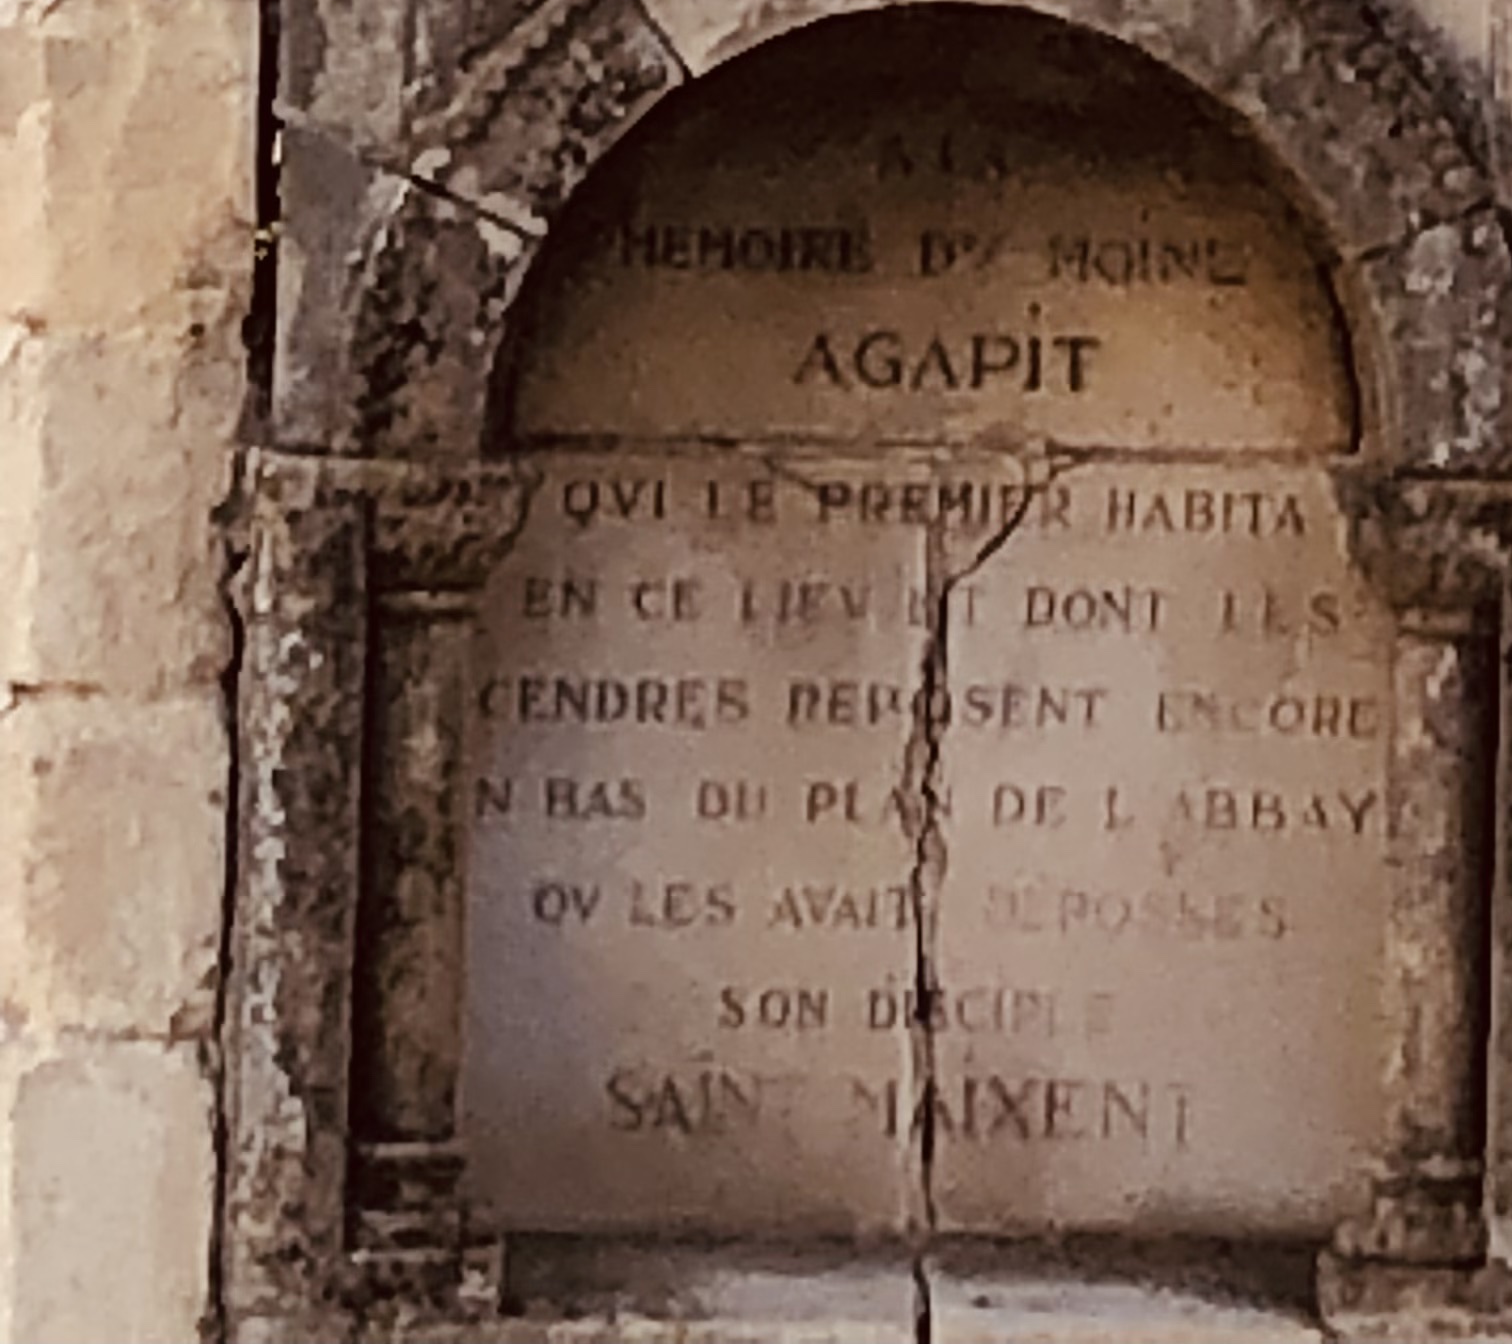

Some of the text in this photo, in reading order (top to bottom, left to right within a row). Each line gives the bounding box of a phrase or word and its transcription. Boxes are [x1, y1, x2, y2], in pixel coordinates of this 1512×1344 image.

[789, 302, 1103, 395] AGAPIT
[563, 478, 667, 531] QVI
[818, 480, 1072, 533] PREMIER
[1105, 486, 1306, 540] HABITA
[523, 576, 598, 619] EN
[632, 576, 702, 624] CE
[1024, 584, 1169, 636] DONT
[478, 675, 1379, 740] CENDRES REPOSENT ENCORE
[544, 776, 647, 822] BAS
[991, 781, 1069, 831] DE
[628, 879, 737, 931] LES
[716, 984, 830, 1032] SON
[849, 1073, 1195, 1154] MAIXENT
